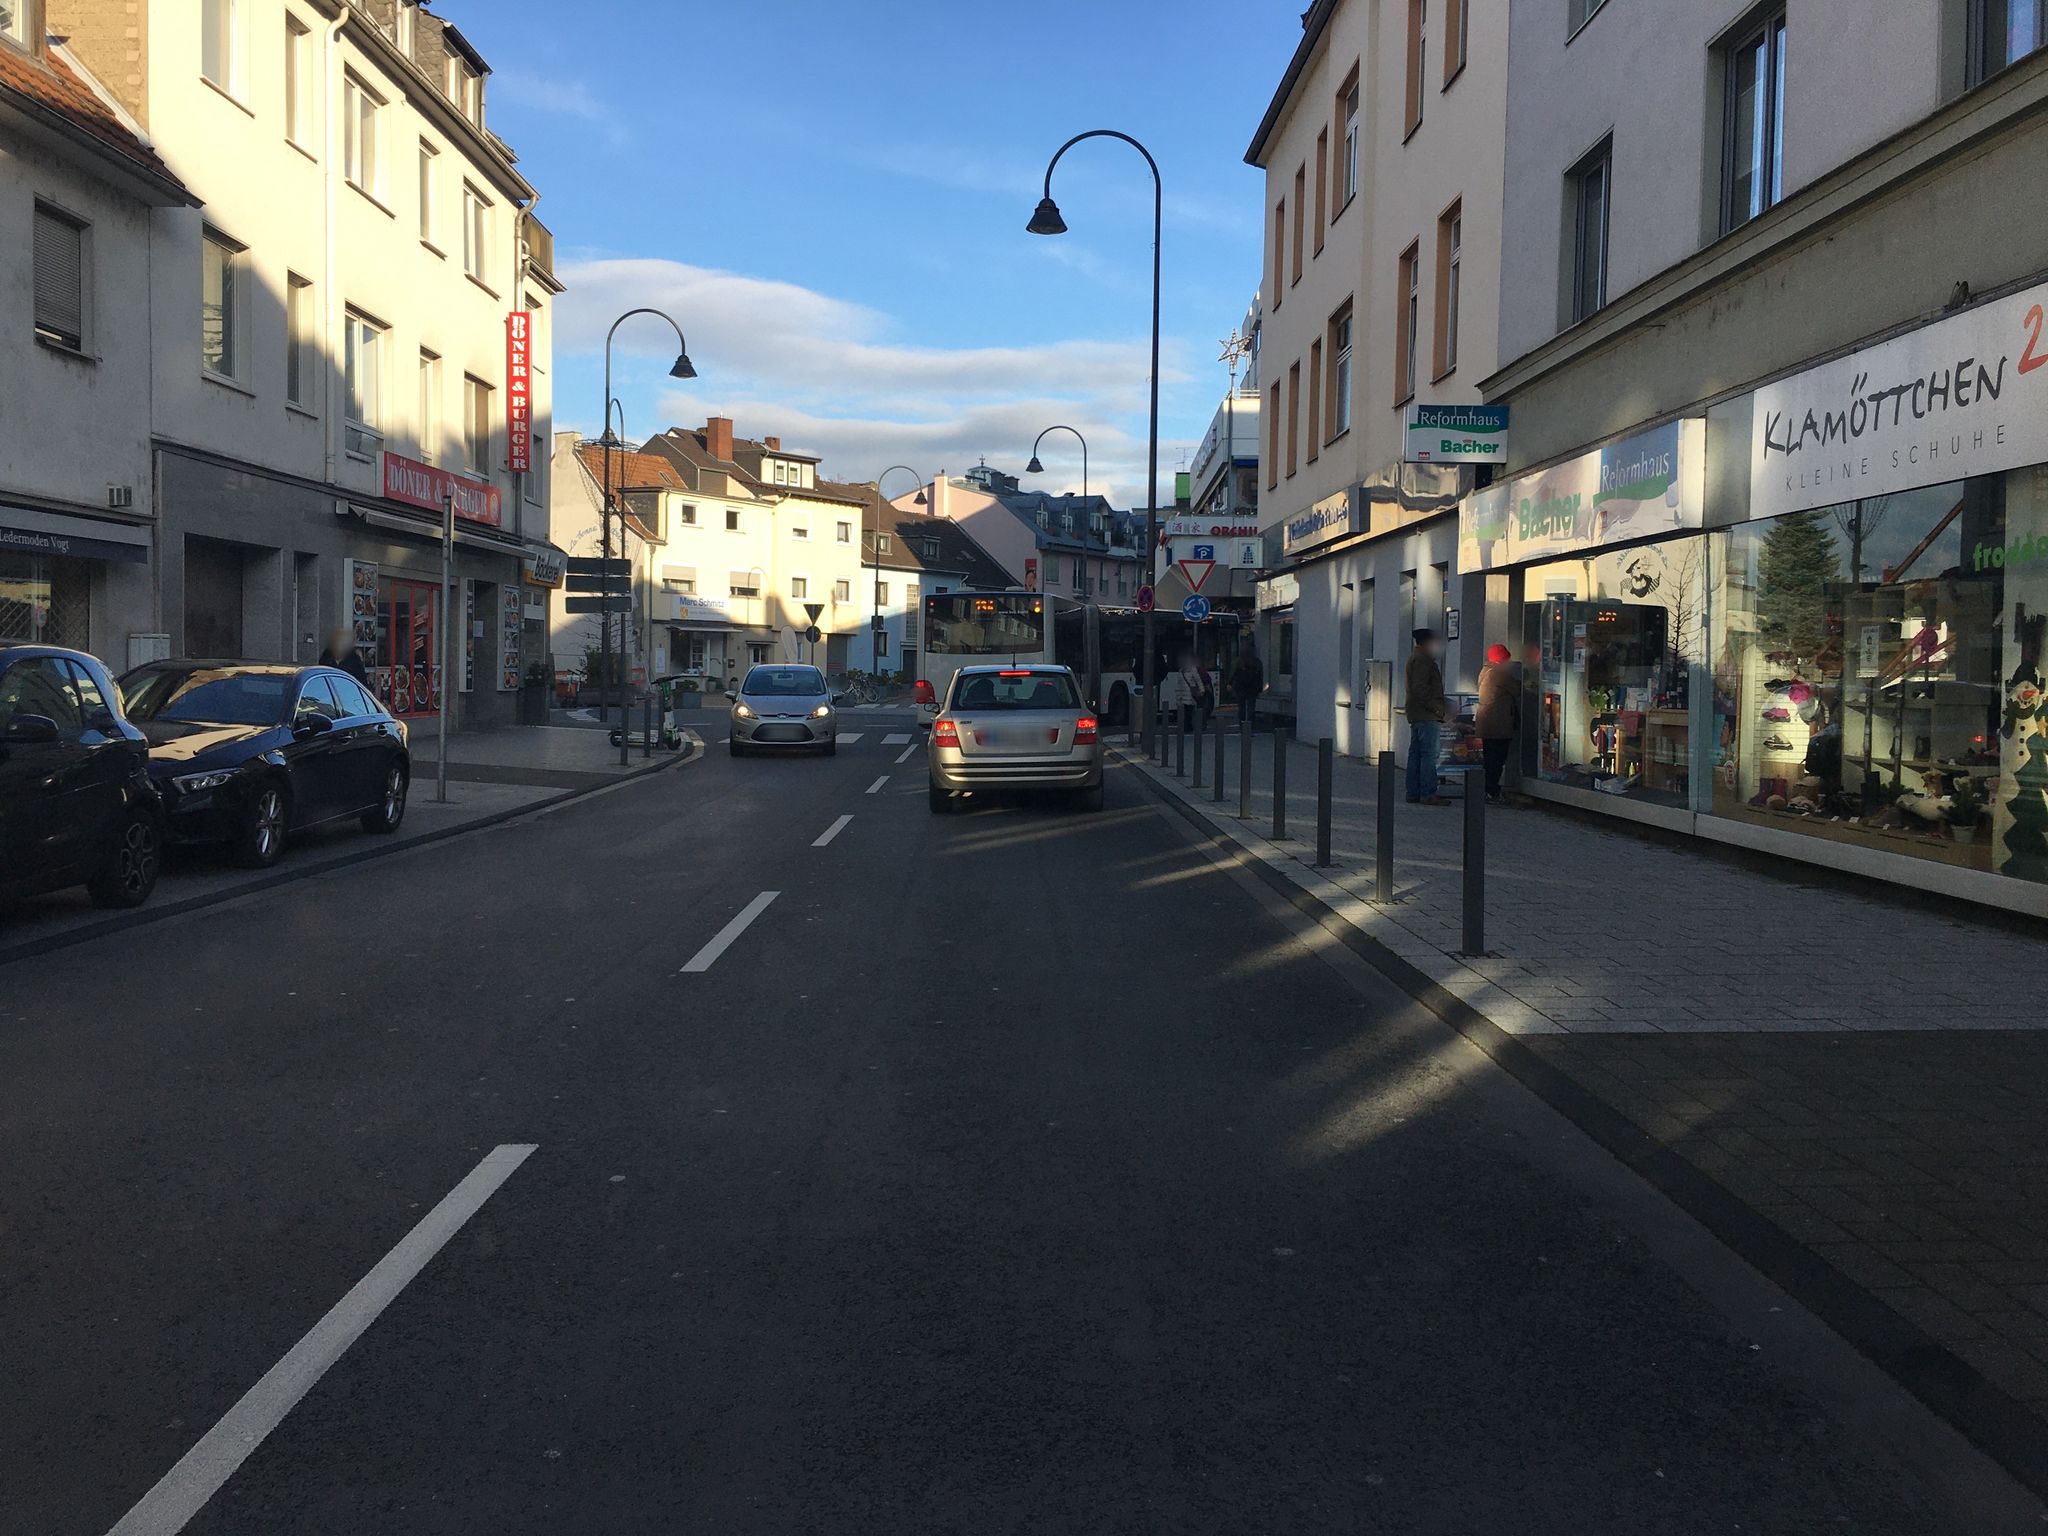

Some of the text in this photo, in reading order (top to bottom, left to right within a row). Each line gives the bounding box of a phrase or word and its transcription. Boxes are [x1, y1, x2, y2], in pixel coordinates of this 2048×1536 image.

[511, 315, 527, 469] DÖNER & BURGER
[1764, 355, 2008, 460] KLAMÖTTCHEN
[1421, 406, 1500, 428] Reformhaus
[1602, 450, 1670, 494] Reformhaus
[1785, 424, 2006, 492] KLEINE SCHUHE
[388, 458, 432, 501] DÖNER
[434, 477, 443, 505] &
[0, 529, 70, 553] Ledermoden Vogt
[680, 597, 698, 606] Marc
